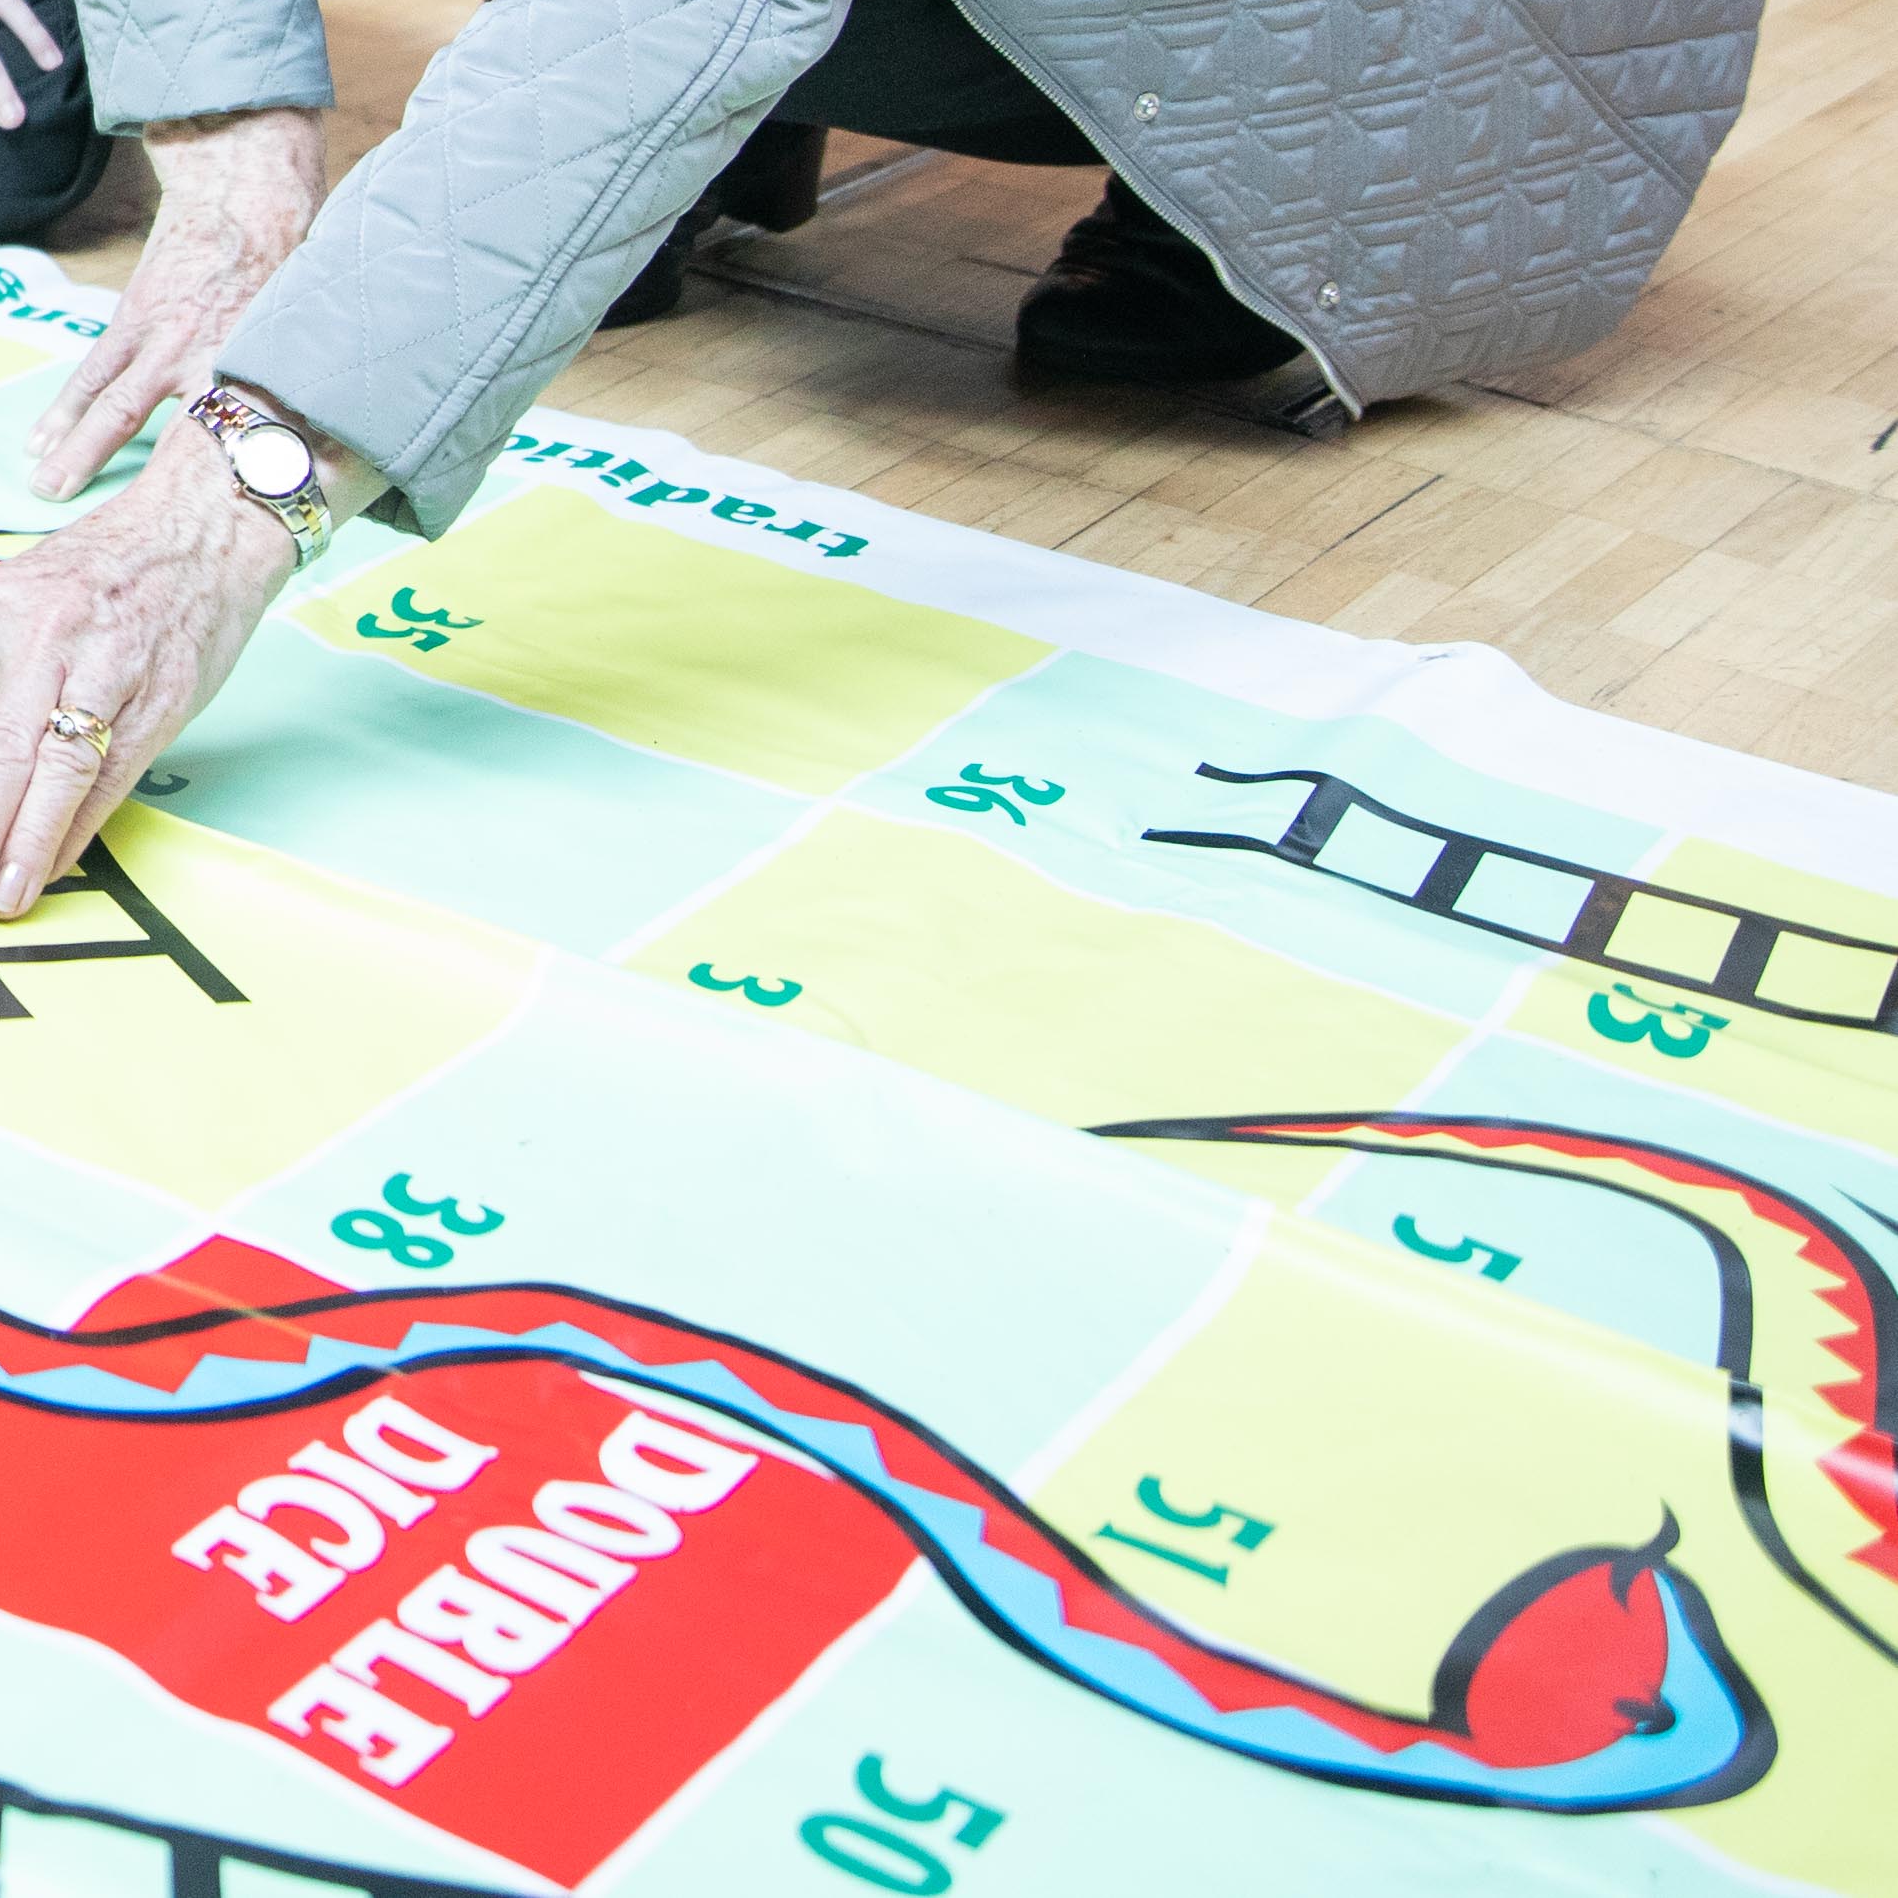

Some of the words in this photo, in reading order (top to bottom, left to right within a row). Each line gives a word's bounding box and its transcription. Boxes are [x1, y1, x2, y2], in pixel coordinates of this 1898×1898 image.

[504, 431, 870, 559] traditio
[355, 586, 485, 652] 35
[924, 762, 1067, 828] 36
[687, 961, 804, 1008] 3
[329, 1171, 507, 1271] 38
[1391, 1212, 1524, 1284] 5
[170, 1393, 500, 1624] DICE
[1092, 1475, 1278, 1587] 51
[266, 1409, 761, 1790] DOUBLE
[797, 1752, 1008, 1897] 50
